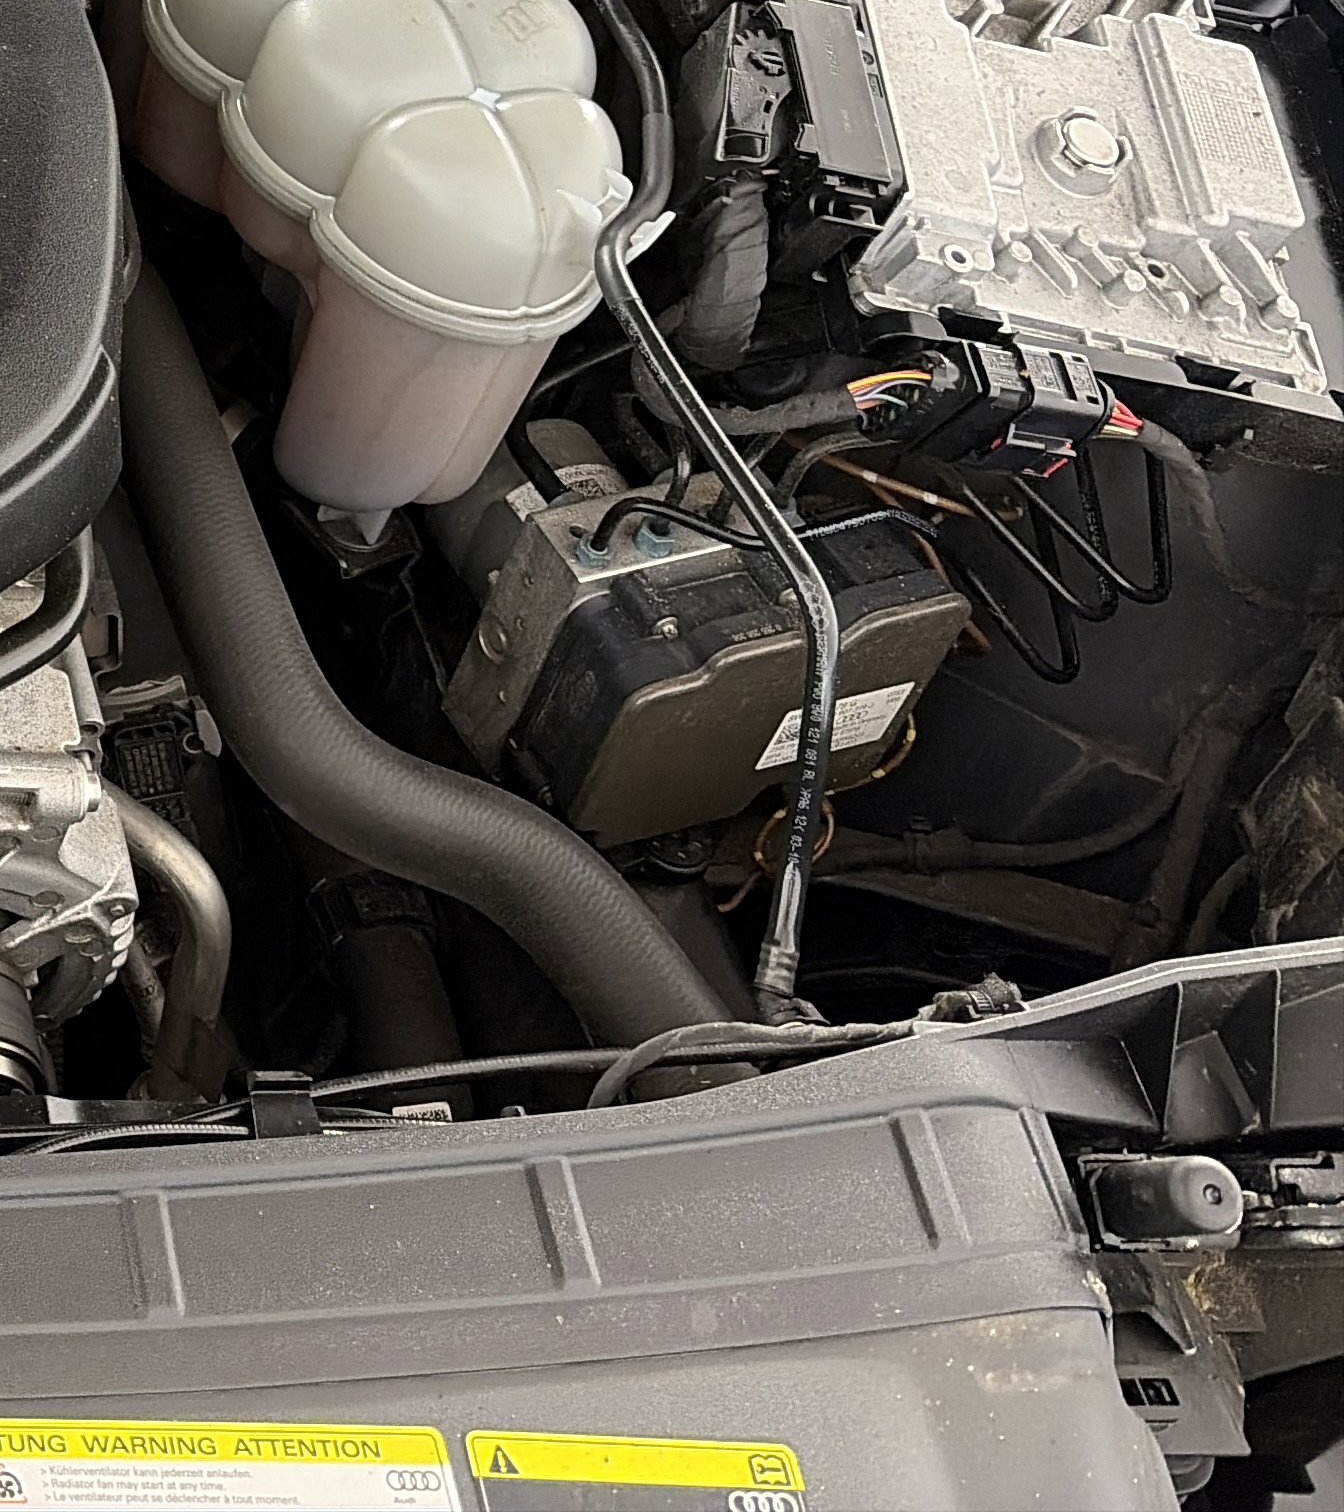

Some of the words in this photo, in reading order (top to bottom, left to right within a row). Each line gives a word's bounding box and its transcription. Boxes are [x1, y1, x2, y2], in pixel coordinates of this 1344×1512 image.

[80, 1434, 217, 1455] WARNING
[233, 1438, 382, 1459] ATTENTION
[51, 1478, 93, 1490] Radiator
[96, 1479, 115, 1490] fan
[116, 1481, 140, 1493] may
[141, 1480, 164, 1491] start
[166, 1481, 176, 1491] at
[178, 1483, 198, 1494] any
[200, 1481, 226, 1492] time.
[67, 1491, 123, 1503] ventilateur
[125, 1494, 148, 1506] peut
[164, 1492, 221, 1504] déclencher
[232, 1494, 254, 1505] tout
[255, 1496, 301, 1506] moment.
[393, 1497, 417, 1505] Audi
